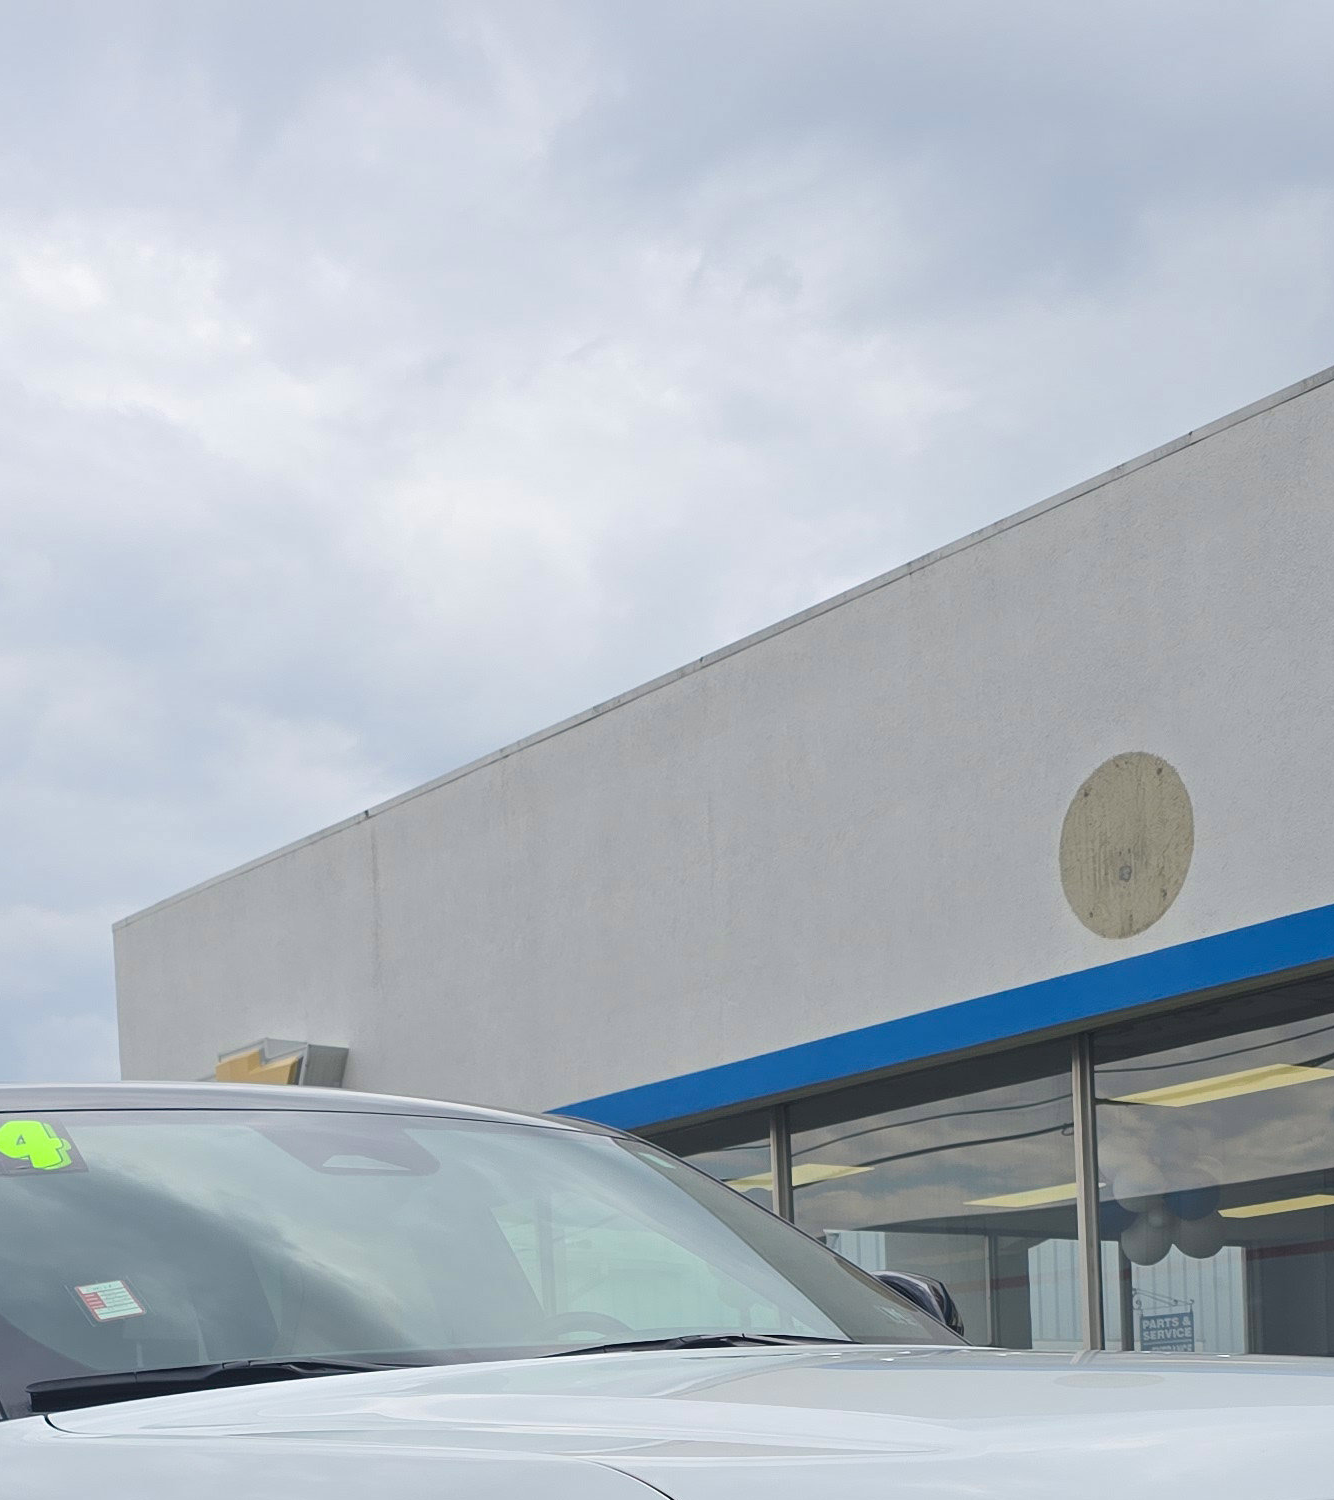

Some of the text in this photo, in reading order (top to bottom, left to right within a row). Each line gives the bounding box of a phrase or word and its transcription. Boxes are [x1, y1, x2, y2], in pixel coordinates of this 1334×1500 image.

[1142, 1316, 1192, 1330] PARTS &
[1142, 1327, 1192, 1341] SERVICE
